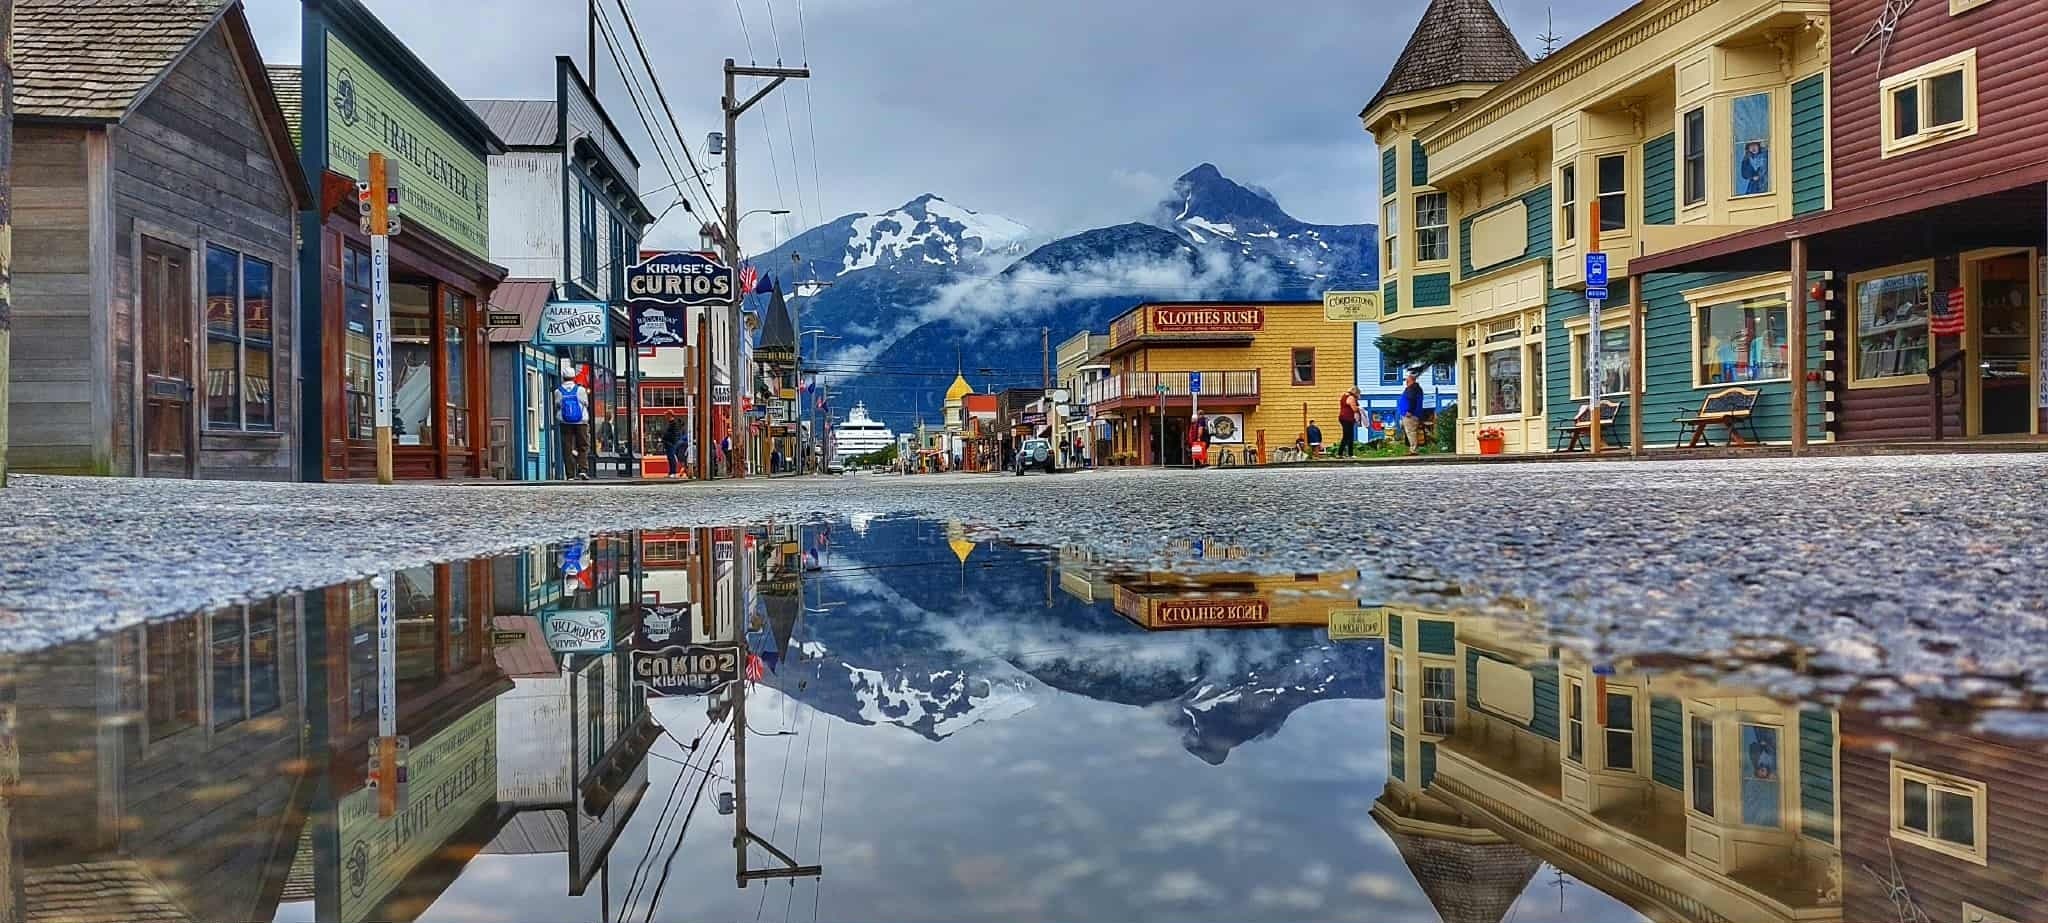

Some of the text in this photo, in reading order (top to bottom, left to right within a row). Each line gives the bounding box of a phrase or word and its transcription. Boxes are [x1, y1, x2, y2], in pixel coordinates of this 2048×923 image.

[382, 111, 421, 167] TRAIL
[425, 147, 469, 200] CENTER
[646, 263, 714, 274] KIRMSE'S
[631, 275, 729, 295] CURIOS
[549, 307, 578, 316] ALASKA
[1158, 311, 1259, 324] KLOTHES RUSH
[375, 255, 385, 407] CITY TRANSIT
[547, 314, 601, 334] ARTWORKS
